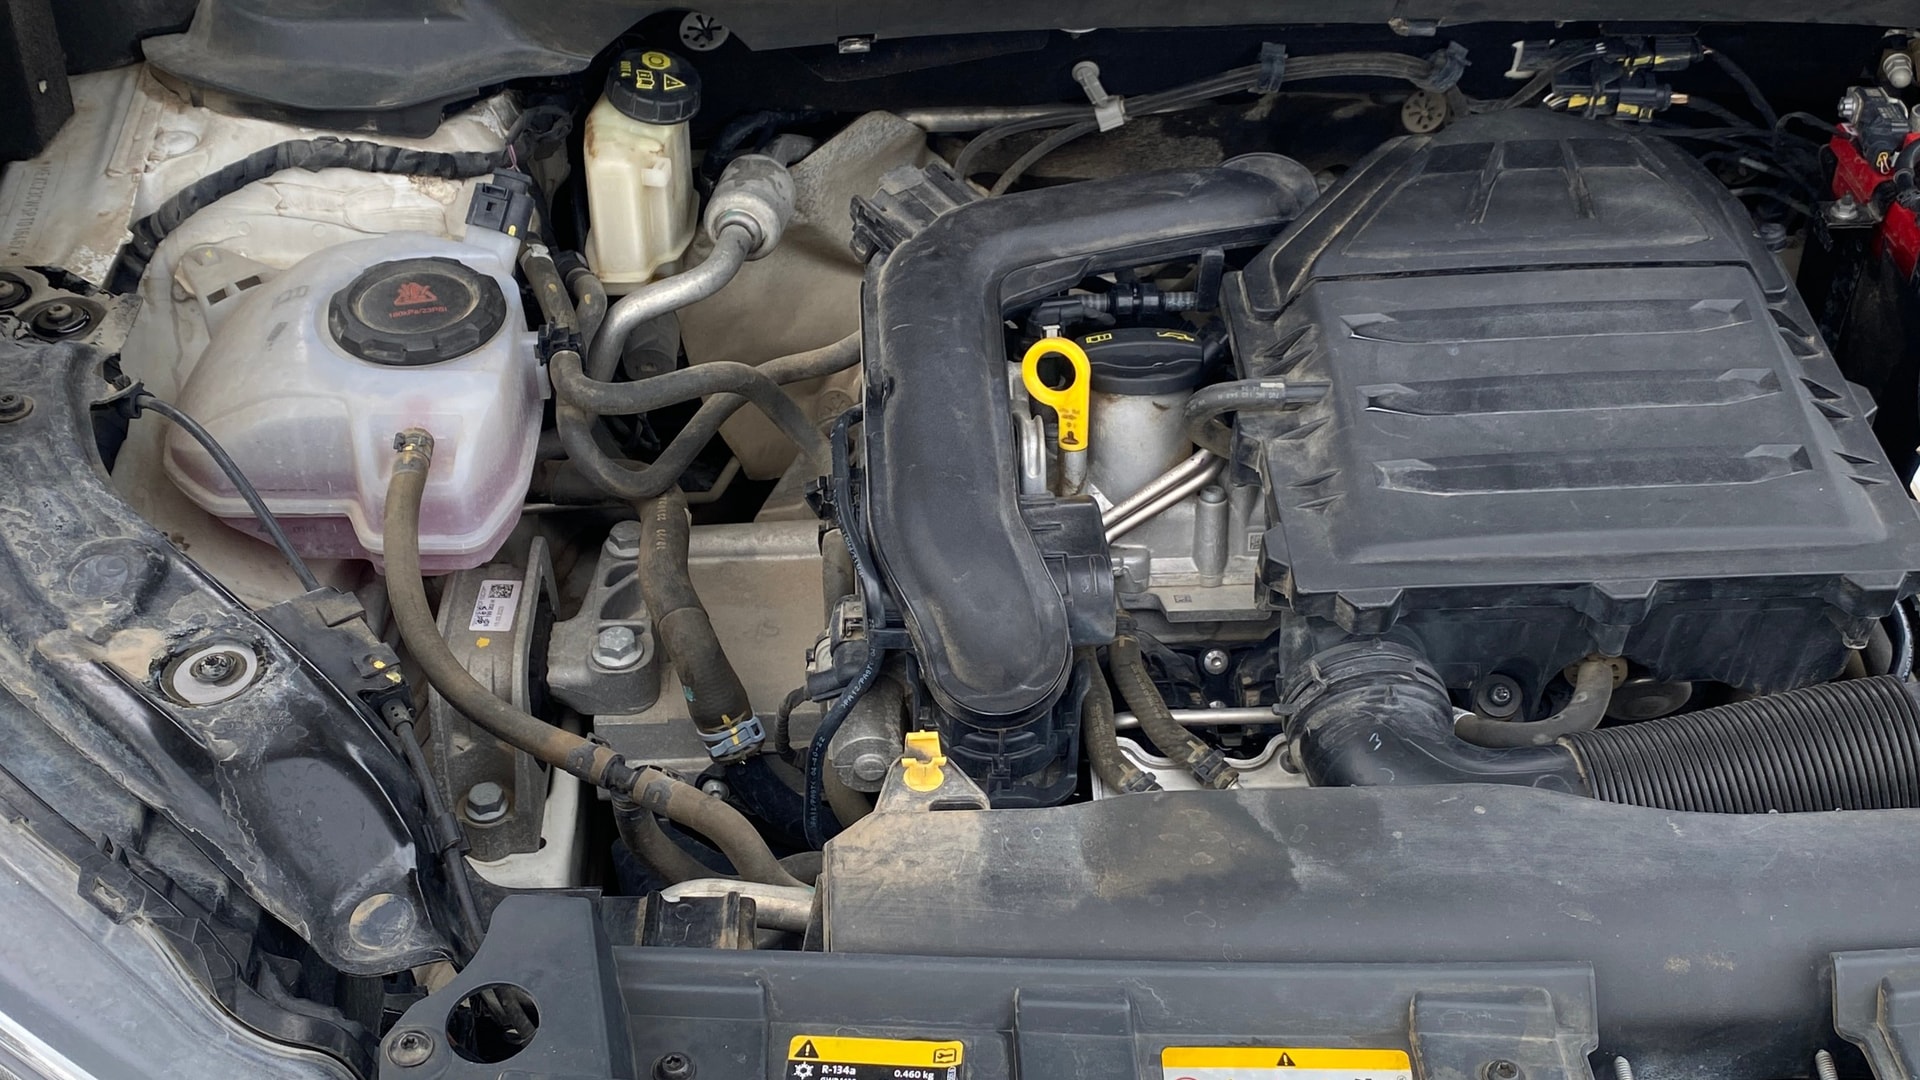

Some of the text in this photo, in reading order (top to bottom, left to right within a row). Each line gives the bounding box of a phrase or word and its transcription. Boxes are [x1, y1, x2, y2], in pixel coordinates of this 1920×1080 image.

[821, 1064, 935, 1080] R-134a 0.460 kg
